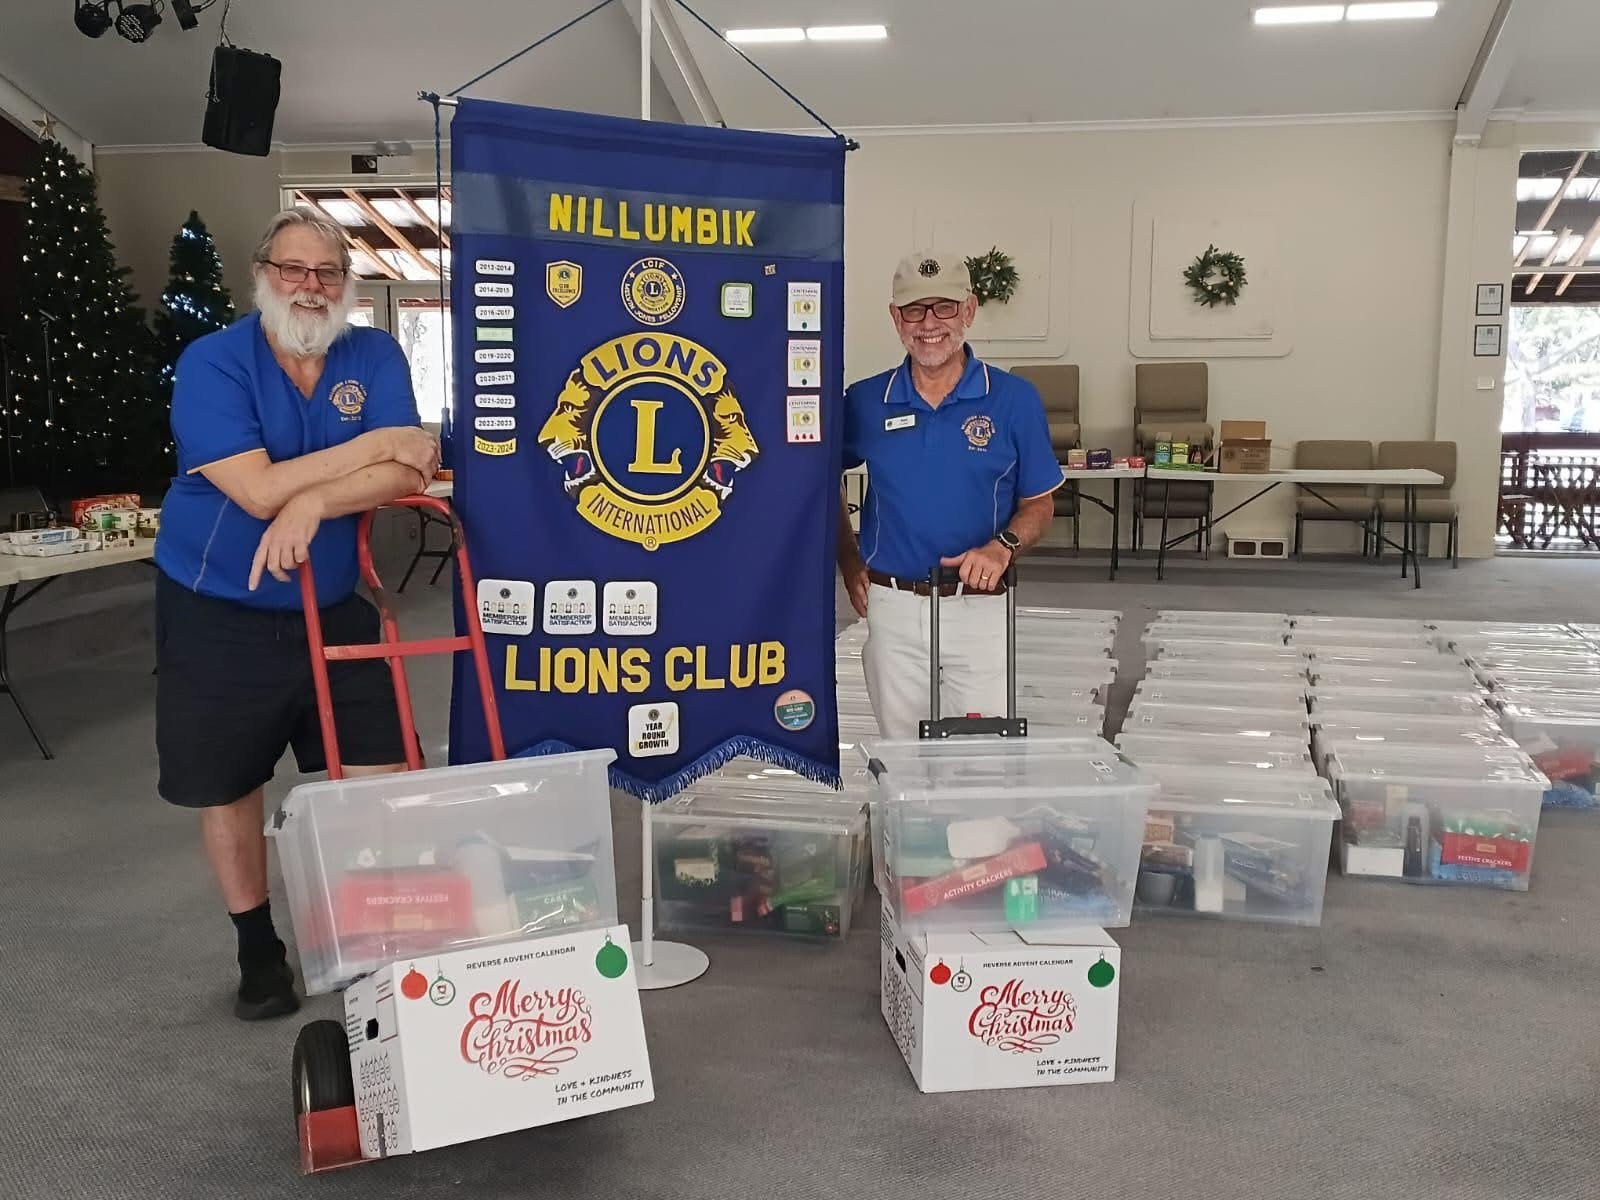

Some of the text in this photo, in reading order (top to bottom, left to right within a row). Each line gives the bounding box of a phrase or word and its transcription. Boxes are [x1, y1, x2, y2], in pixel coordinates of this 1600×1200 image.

[550, 193, 756, 247] NILLUMBIK
[641, 260, 666, 269] LCIF
[624, 282, 682, 322] MELVIN JONES FELLOWSHIP
[650, 282, 659, 295] L
[591, 337, 718, 388] LIONS
[477, 440, 514, 454] 2023-2024
[628, 400, 682, 474] L
[586, 493, 712, 535] INTERNATIONAL
[505, 641, 786, 694] LIONS CLUB
[642, 731, 666, 740] ROUND
[645, 722, 663, 731] YEAR
[639, 740, 669, 749] GROWTH
[1481, 858, 1512, 867] CRACKERS
[944, 868, 1013, 900] ACTIVITY CRACKERS
[466, 946, 576, 970] REVERSE ADVENT CALENDAR
[469, 979, 581, 1020] Merry
[980, 979, 1069, 1014] Merry
[969, 1003, 1073, 1038] Christmas
[460, 1014, 592, 1064] Christmas
[555, 1080, 578, 1093] LOVE
[589, 1070, 632, 1085] KINDNESS
[1064, 1066, 1109, 1074] COMMUNITY
[557, 1080, 645, 1105] IN THE COMMUNITY
